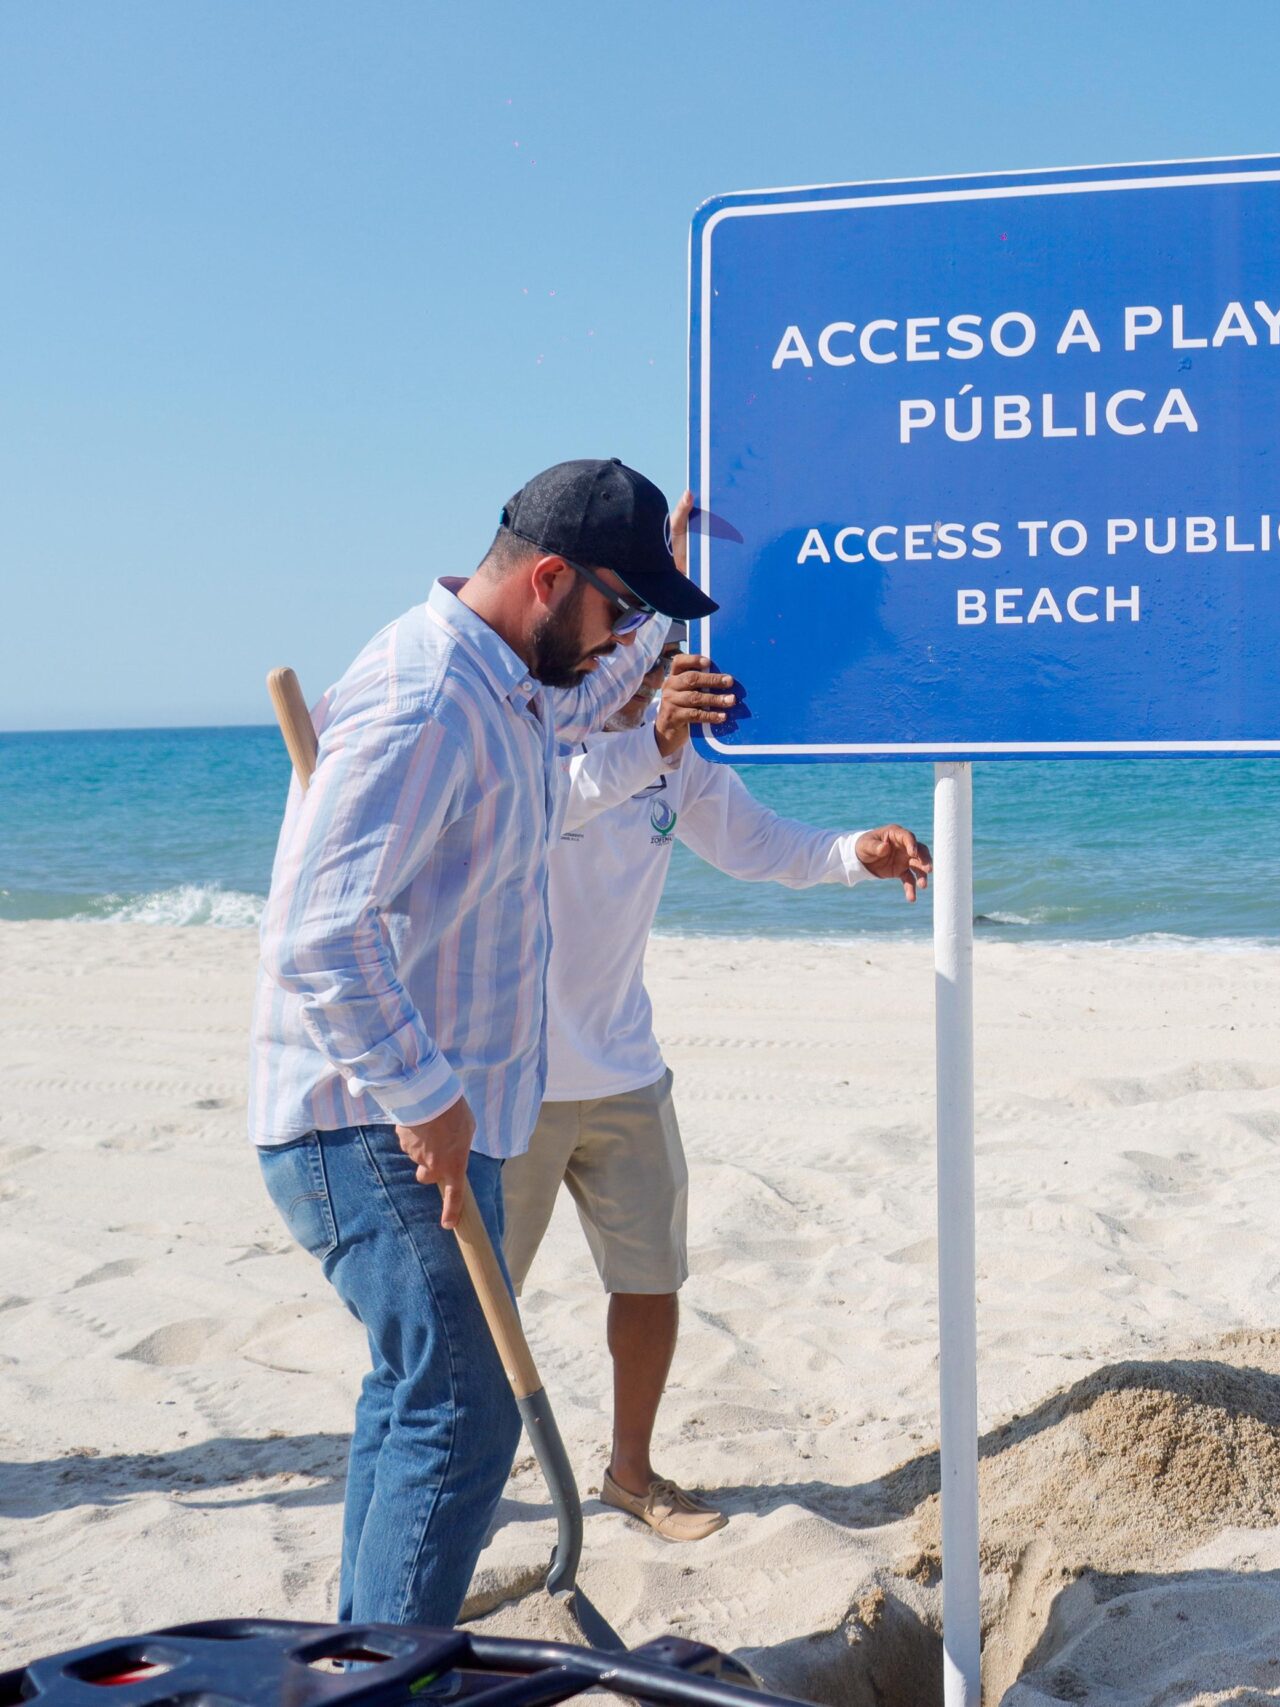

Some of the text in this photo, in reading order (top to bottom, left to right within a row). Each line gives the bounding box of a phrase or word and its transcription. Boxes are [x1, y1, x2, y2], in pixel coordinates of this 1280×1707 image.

[772, 312, 1035, 369] ACCESO
[1057, 310, 1100, 354] A
[900, 384, 1198, 443] PÚBLICA
[797, 522, 1001, 564] ACCESS
[1018, 520, 1088, 557] TO
[957, 586, 1140, 625] BEACH
